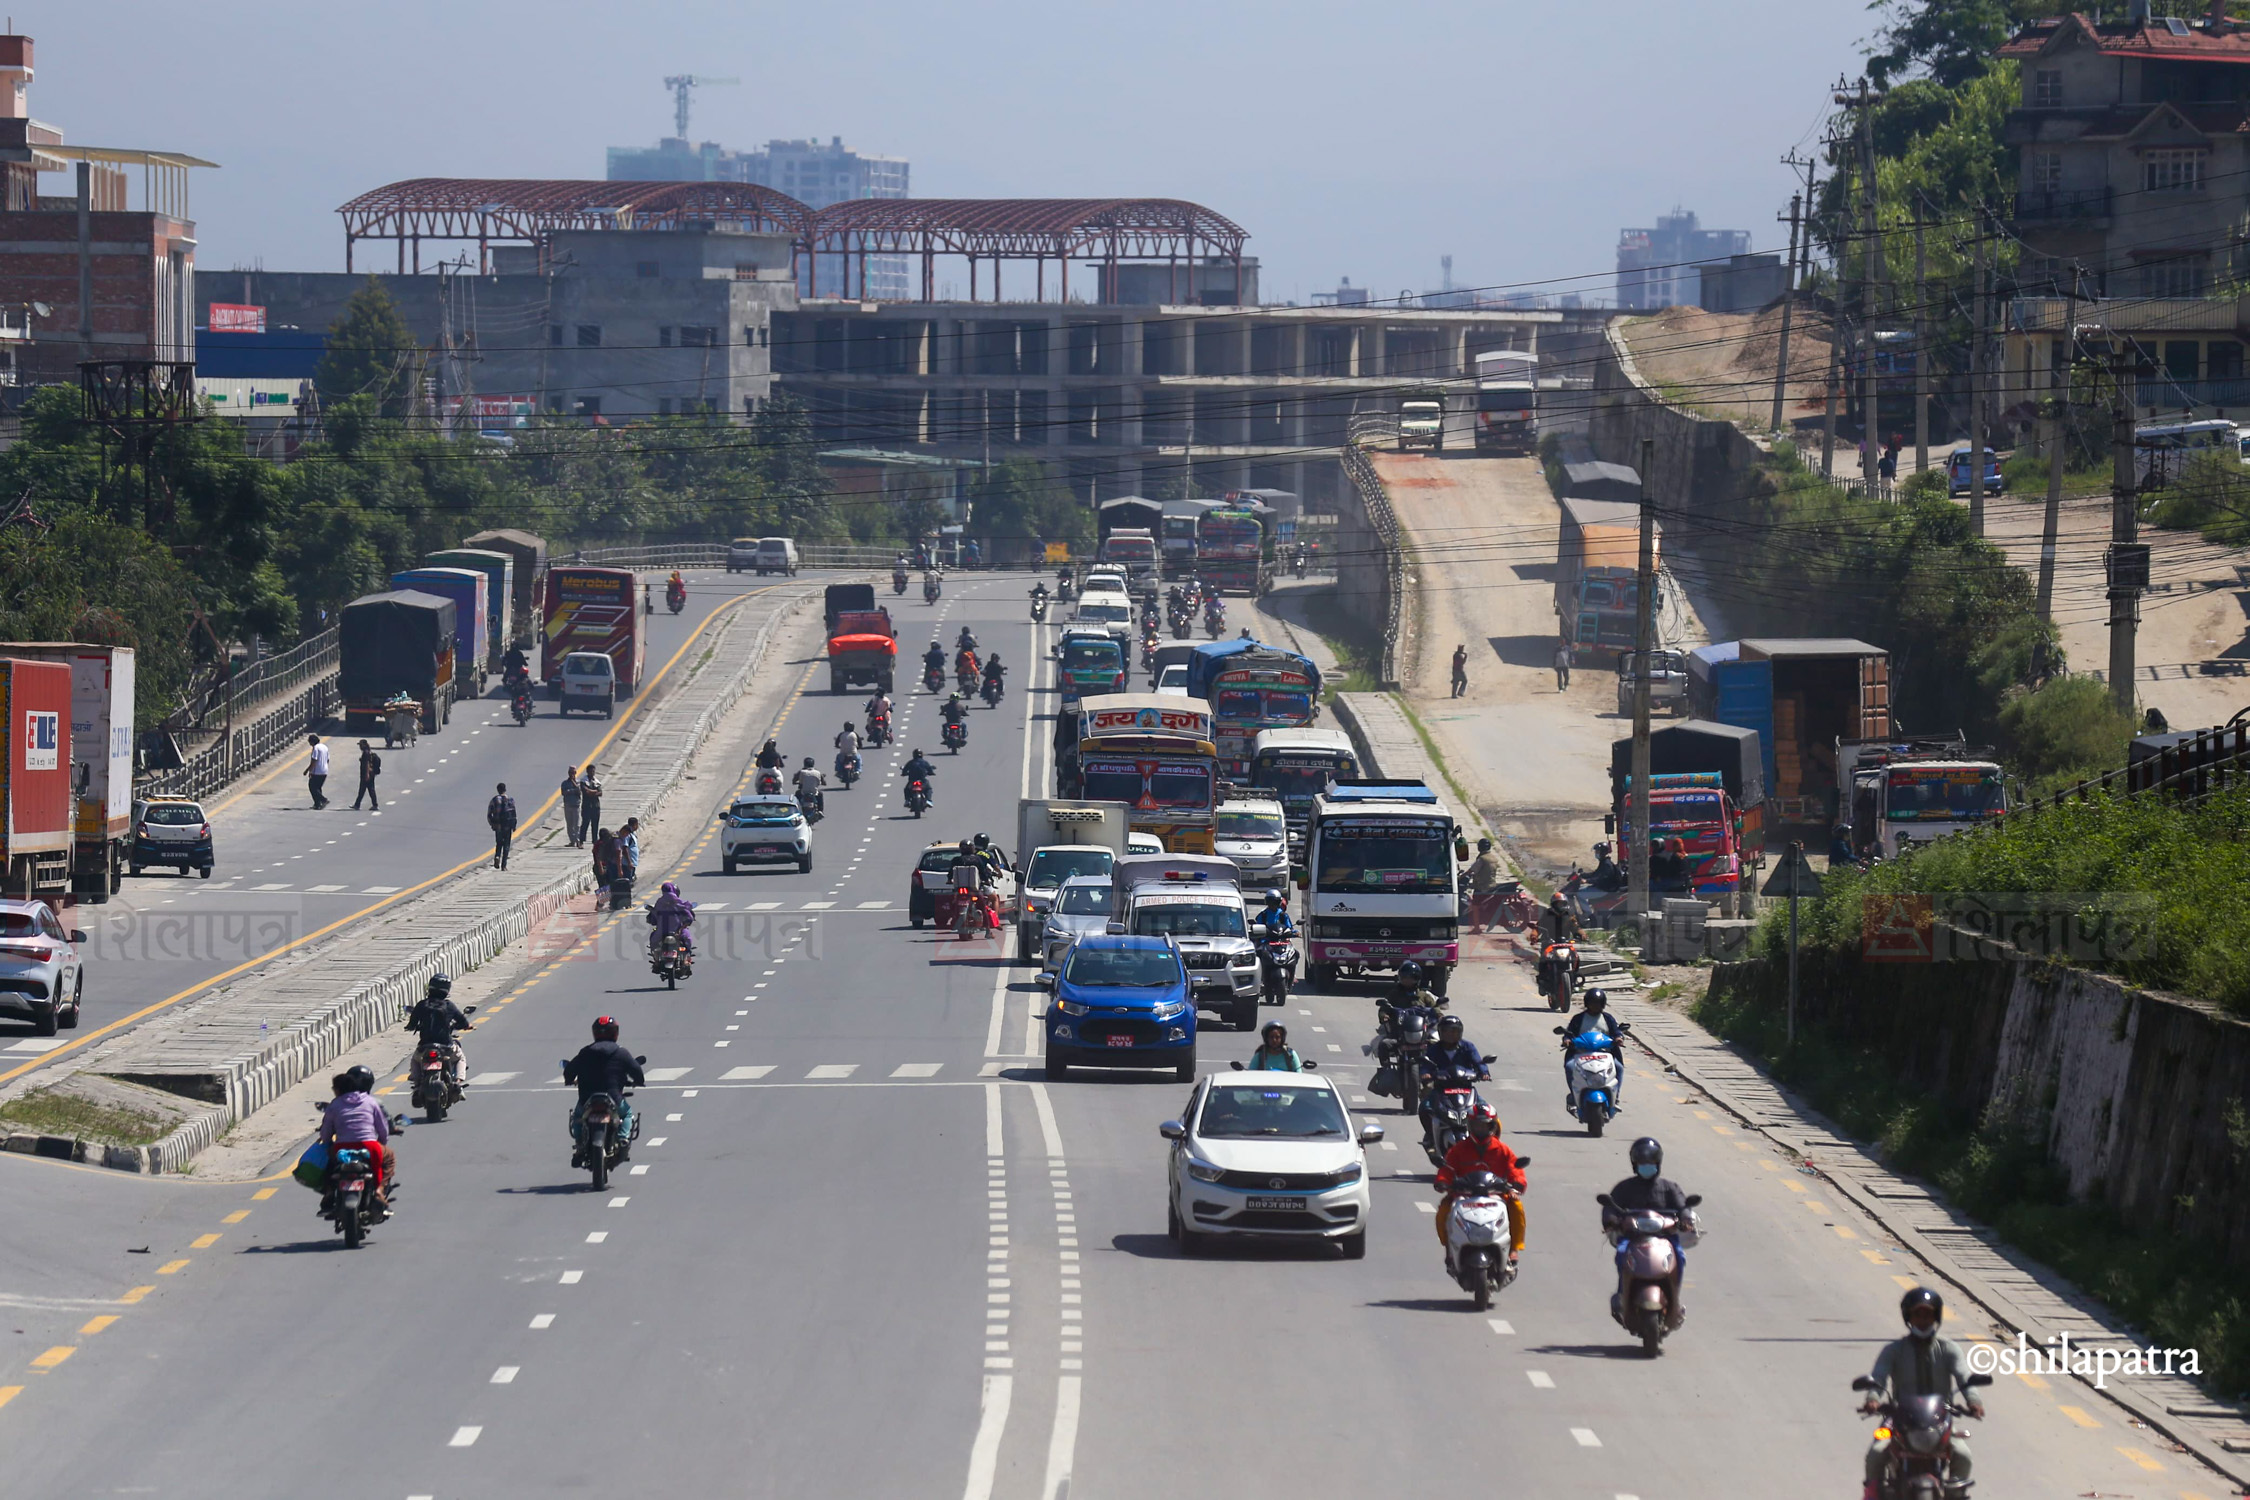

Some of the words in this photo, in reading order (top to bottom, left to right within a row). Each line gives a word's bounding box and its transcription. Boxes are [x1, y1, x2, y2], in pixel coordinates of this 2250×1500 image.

[562, 575, 620, 589] Merobus
[1095, 711, 1137, 728] जय
[1141, 897, 1168, 905] ARMED
[1171, 896, 1199, 904] POLICE
